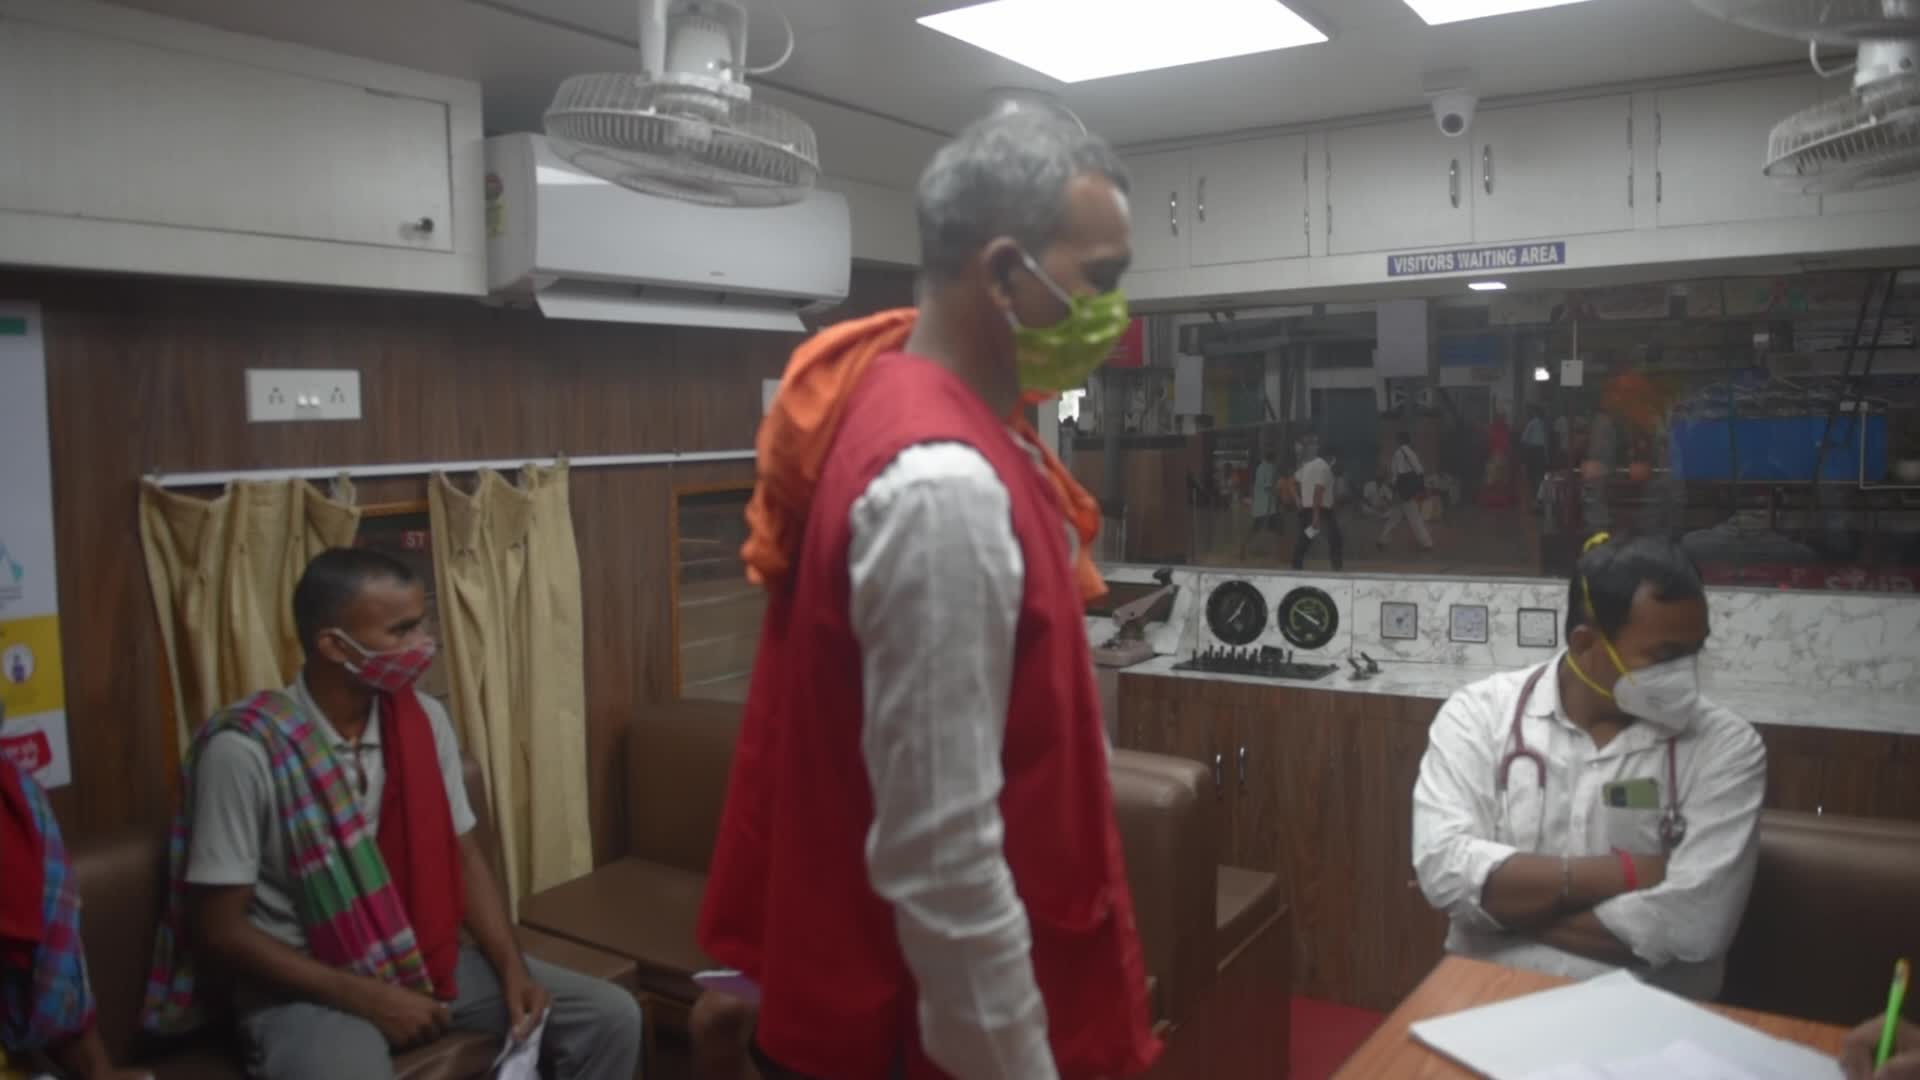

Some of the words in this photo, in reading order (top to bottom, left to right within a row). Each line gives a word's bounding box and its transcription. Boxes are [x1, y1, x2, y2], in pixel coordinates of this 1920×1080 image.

[1394, 253, 1454, 273] VISITORS
[1457, 248, 1517, 269] WAITING
[1521, 245, 1558, 264] AREA
